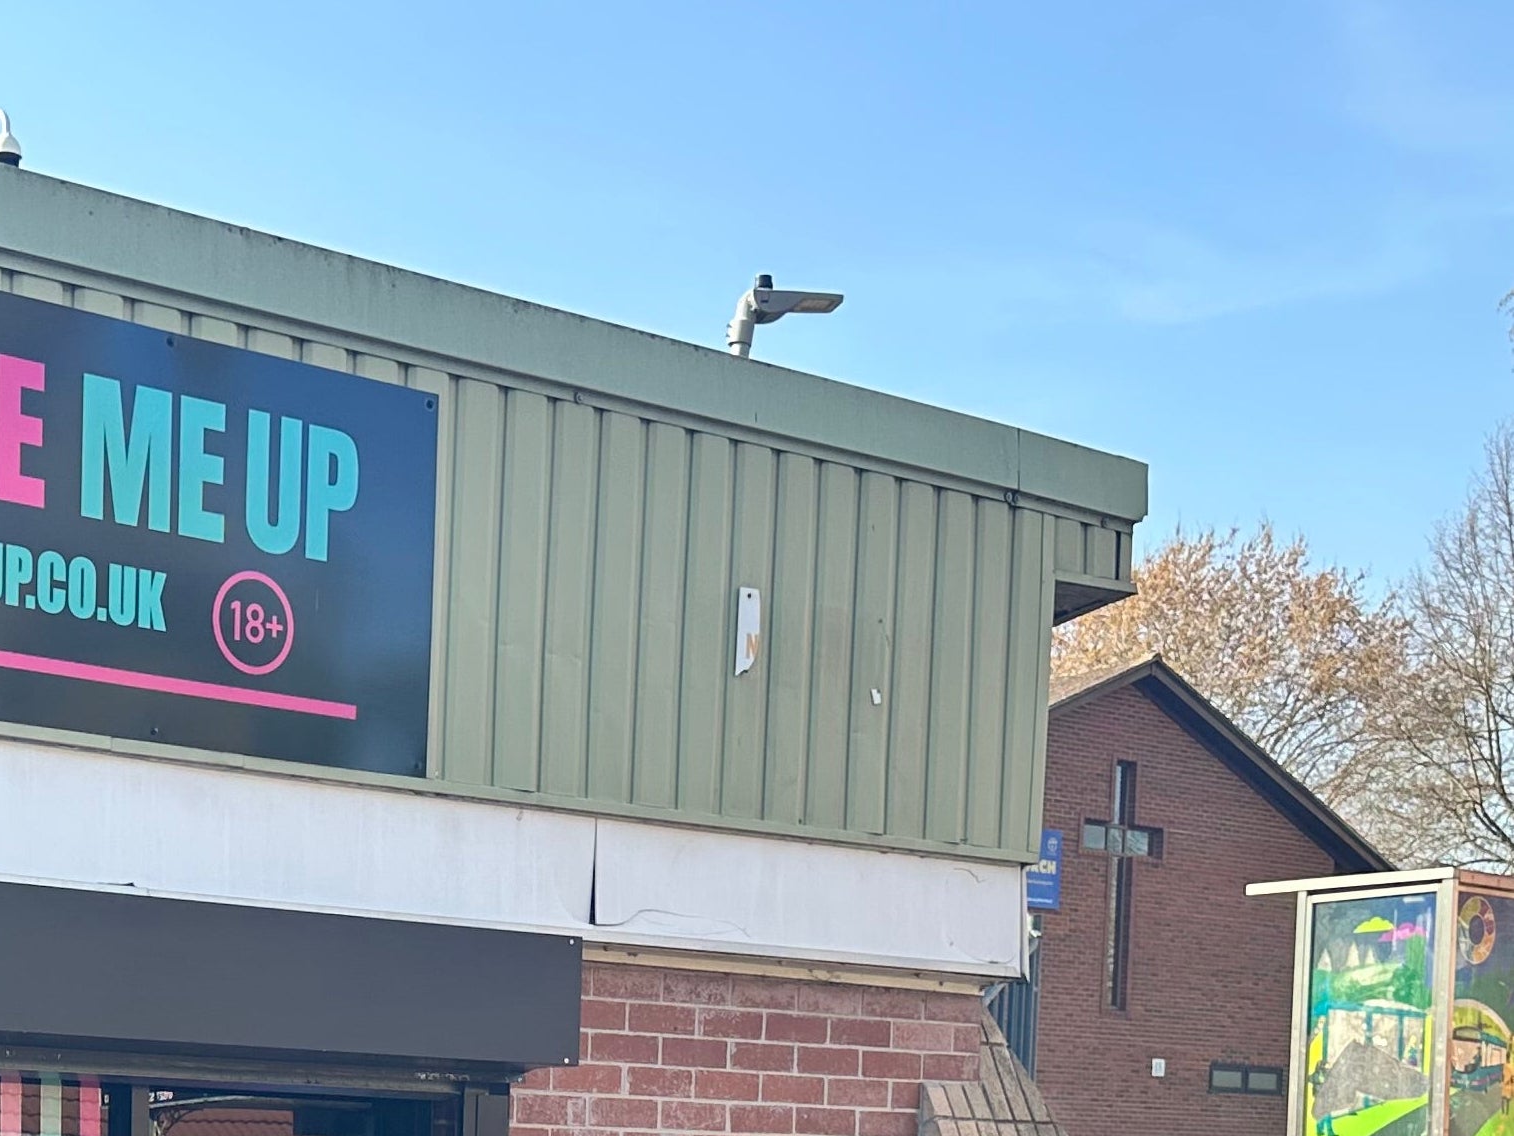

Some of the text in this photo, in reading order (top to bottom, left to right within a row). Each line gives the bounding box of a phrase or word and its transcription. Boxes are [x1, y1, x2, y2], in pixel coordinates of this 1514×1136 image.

[80, 372, 226, 544] ME
[245, 408, 360, 563] UP
[230, 600, 284, 645] 18+
